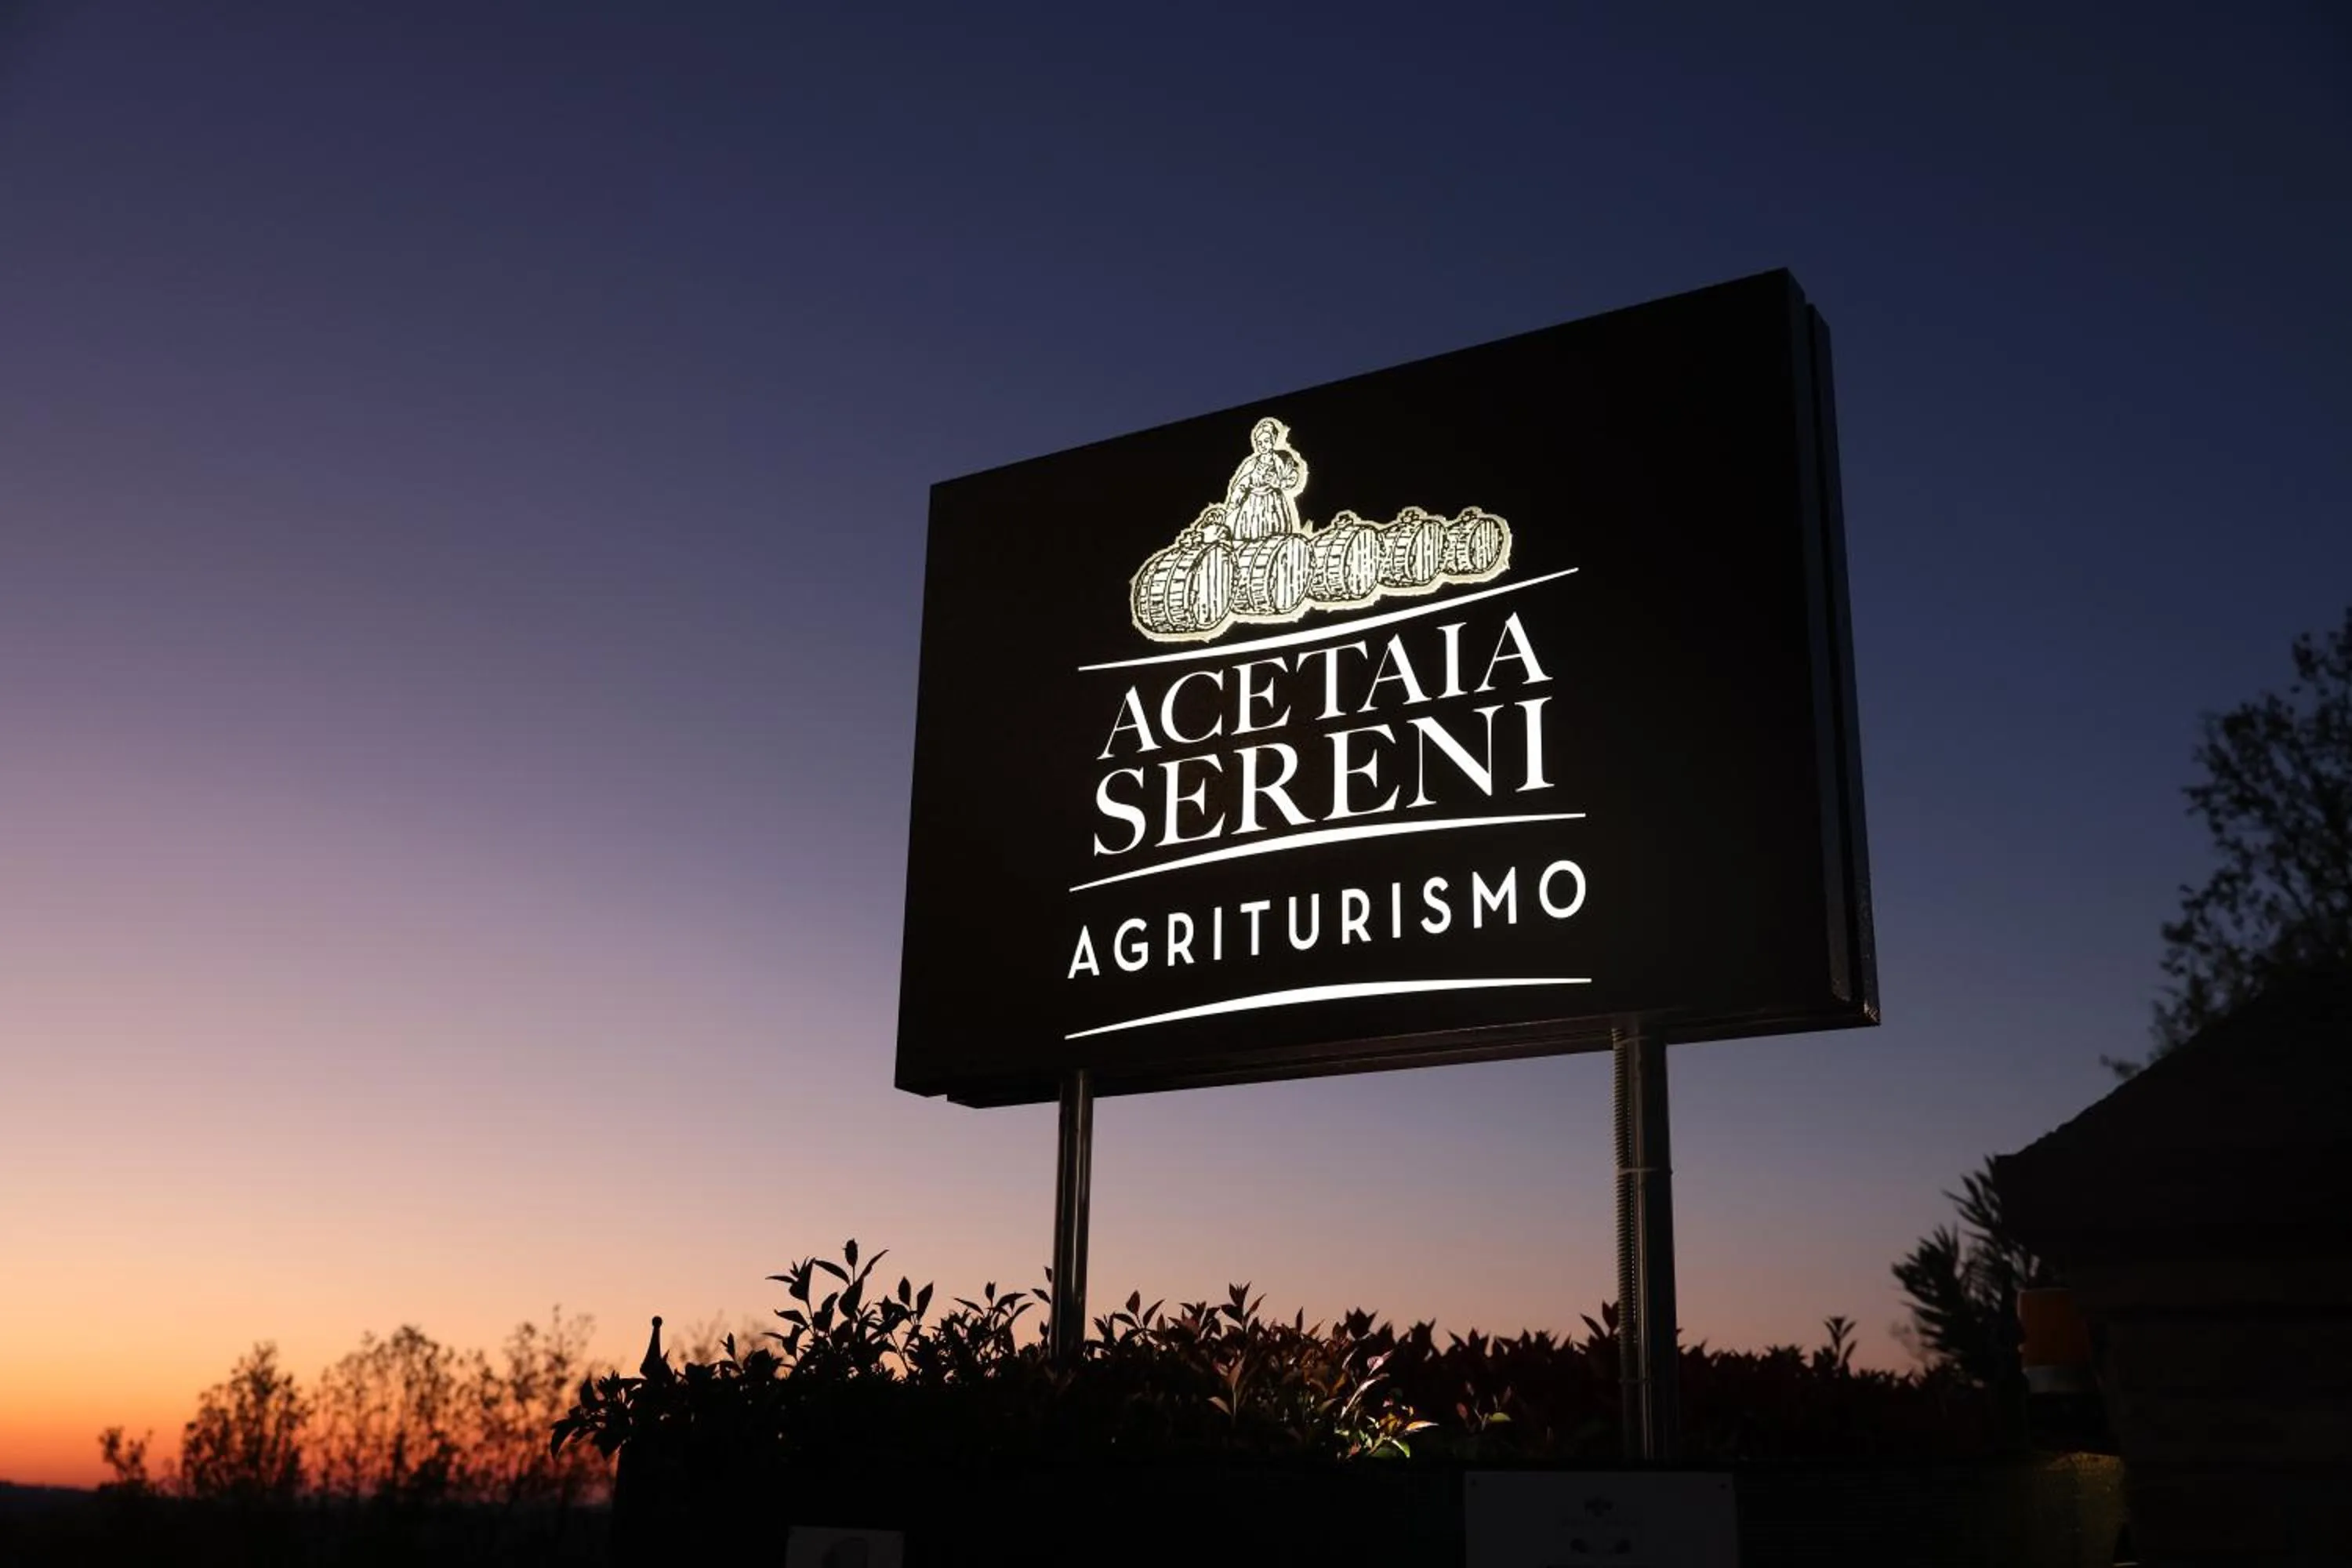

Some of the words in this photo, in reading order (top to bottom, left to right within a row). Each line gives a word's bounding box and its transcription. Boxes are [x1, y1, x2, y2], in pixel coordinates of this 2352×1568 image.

[1097, 612, 1553, 760] ACETAIA
[1093, 695, 1555, 856] SERENI
[1067, 859, 1586, 979] AGRITURISMO
